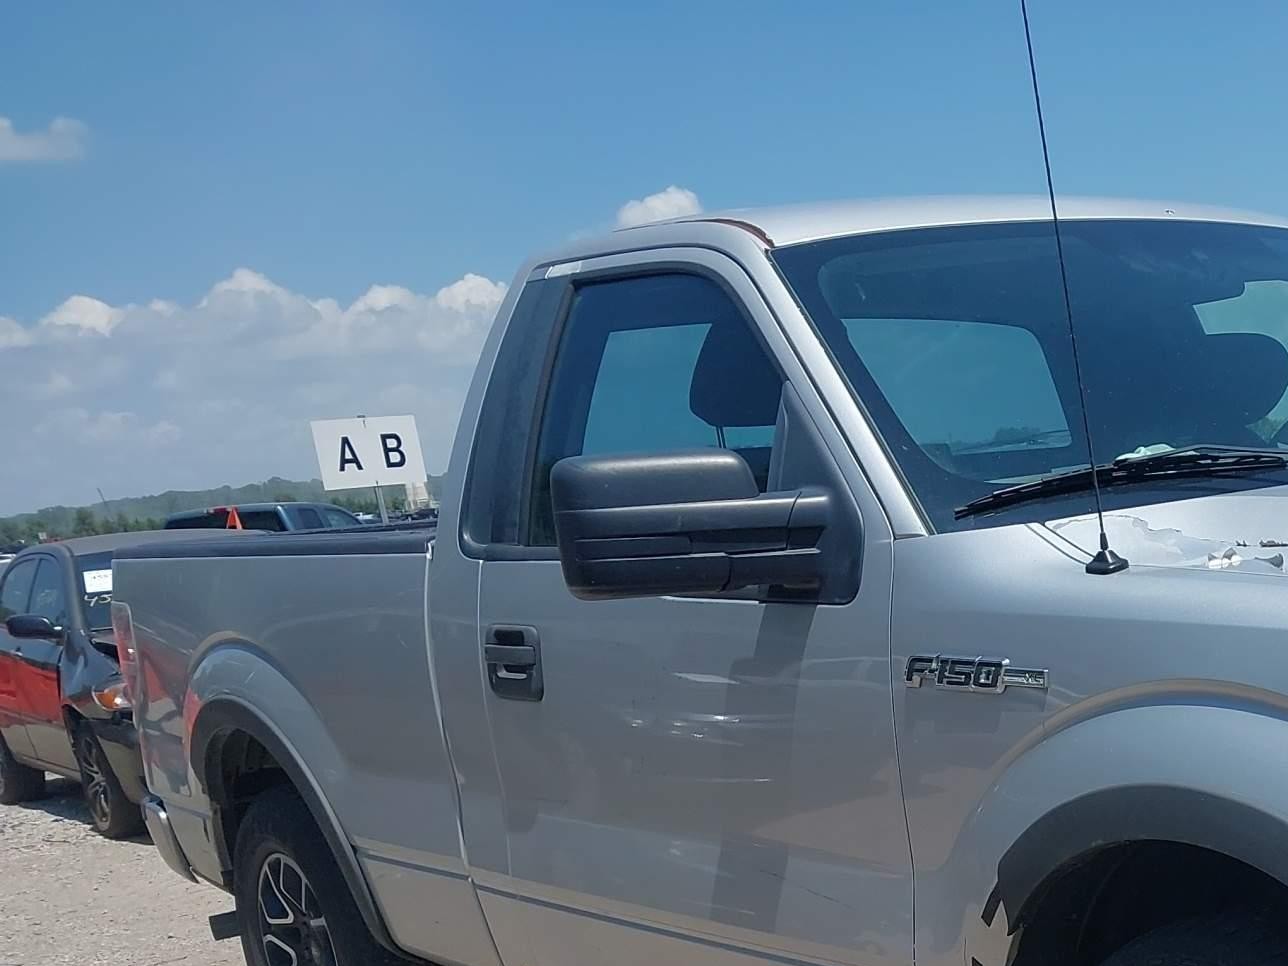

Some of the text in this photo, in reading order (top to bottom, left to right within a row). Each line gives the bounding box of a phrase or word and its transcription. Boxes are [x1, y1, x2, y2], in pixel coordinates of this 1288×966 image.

[338, 433, 406, 472] A B
[904, 654, 1009, 694] F-150
